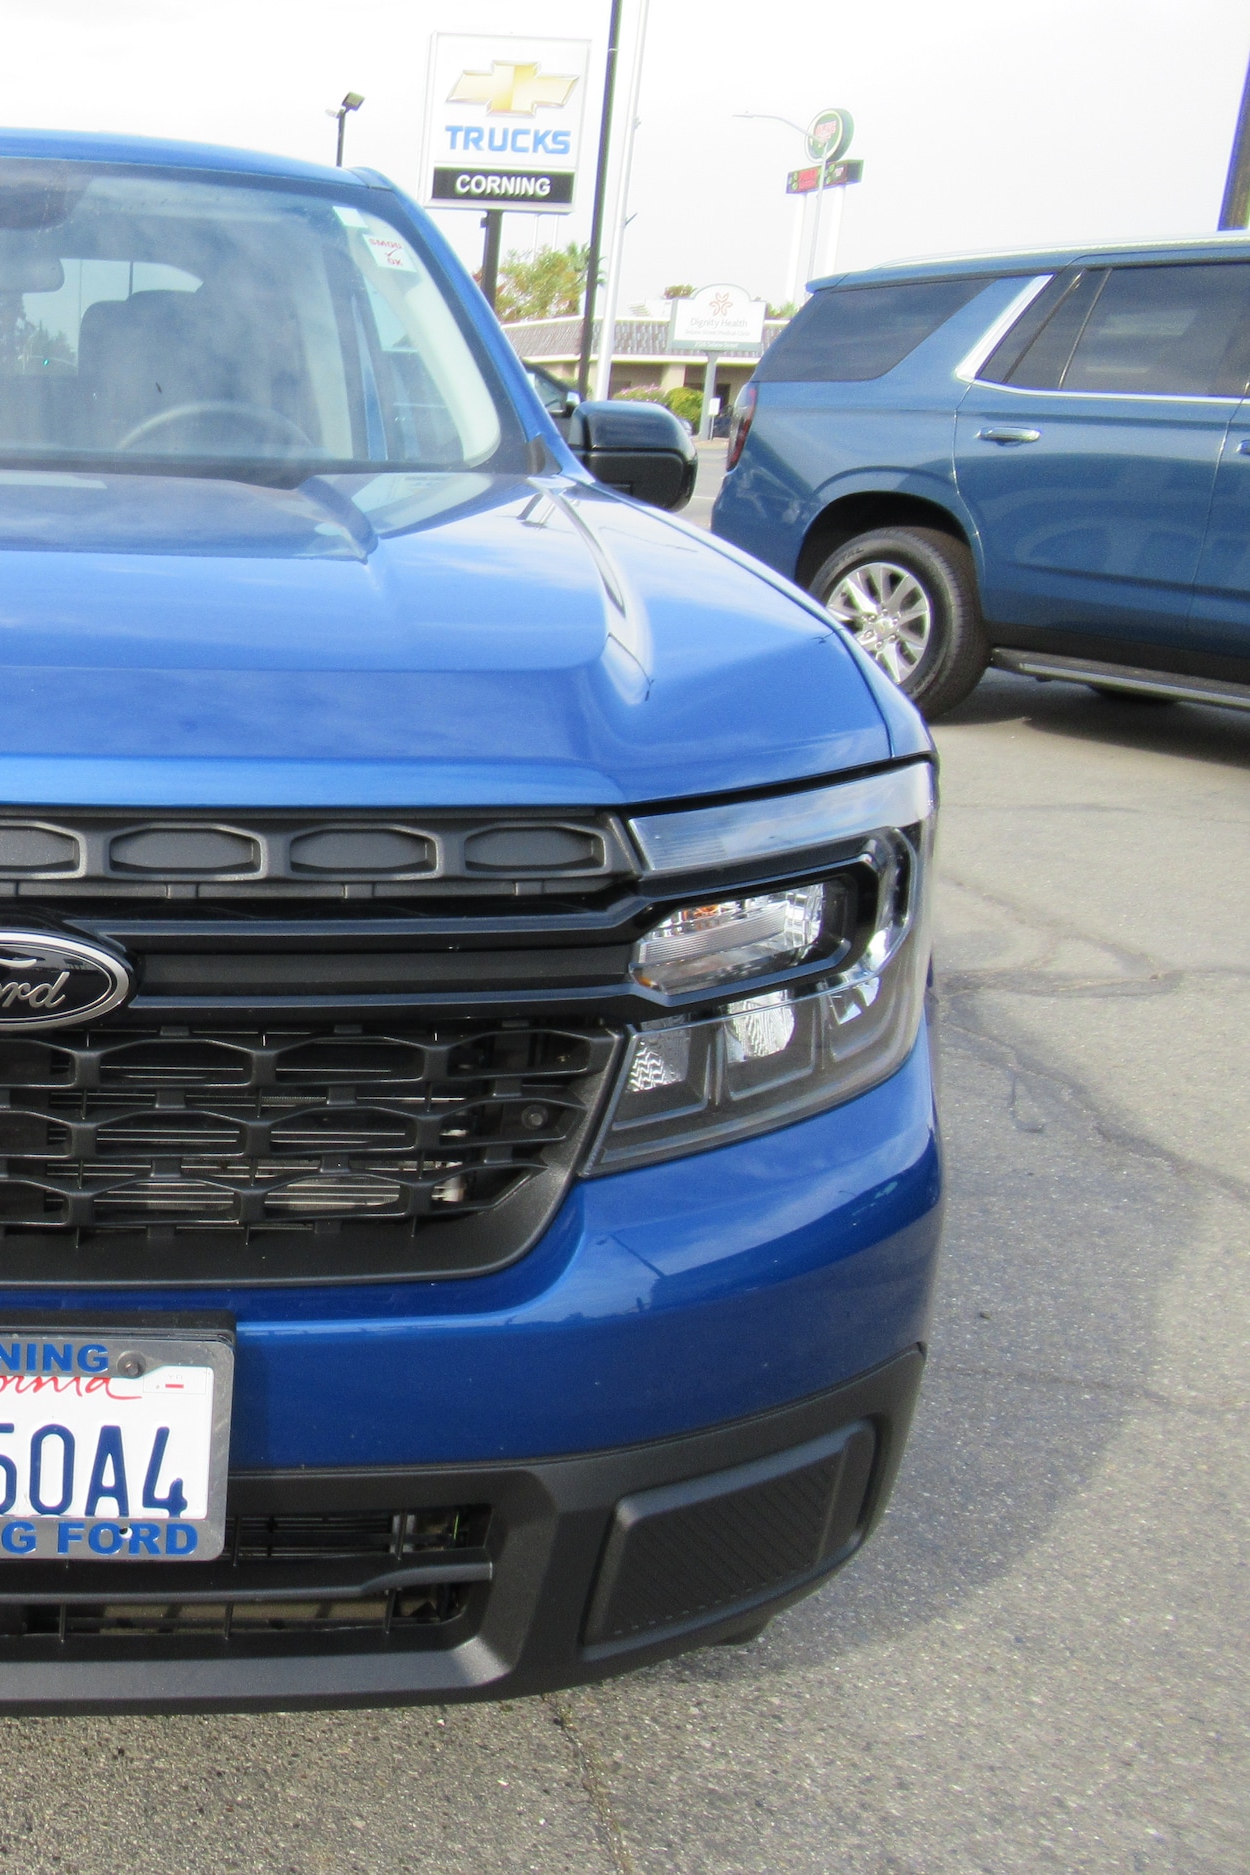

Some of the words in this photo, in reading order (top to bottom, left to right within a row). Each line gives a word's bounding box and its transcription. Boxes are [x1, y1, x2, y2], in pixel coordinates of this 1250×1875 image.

[445, 125, 571, 154] TRUCKS
[455, 173, 551, 196] CORNING
[690, 317, 720, 329] Dignity
[721, 319, 748, 328] Health
[57, 1521, 198, 1556] FORD
